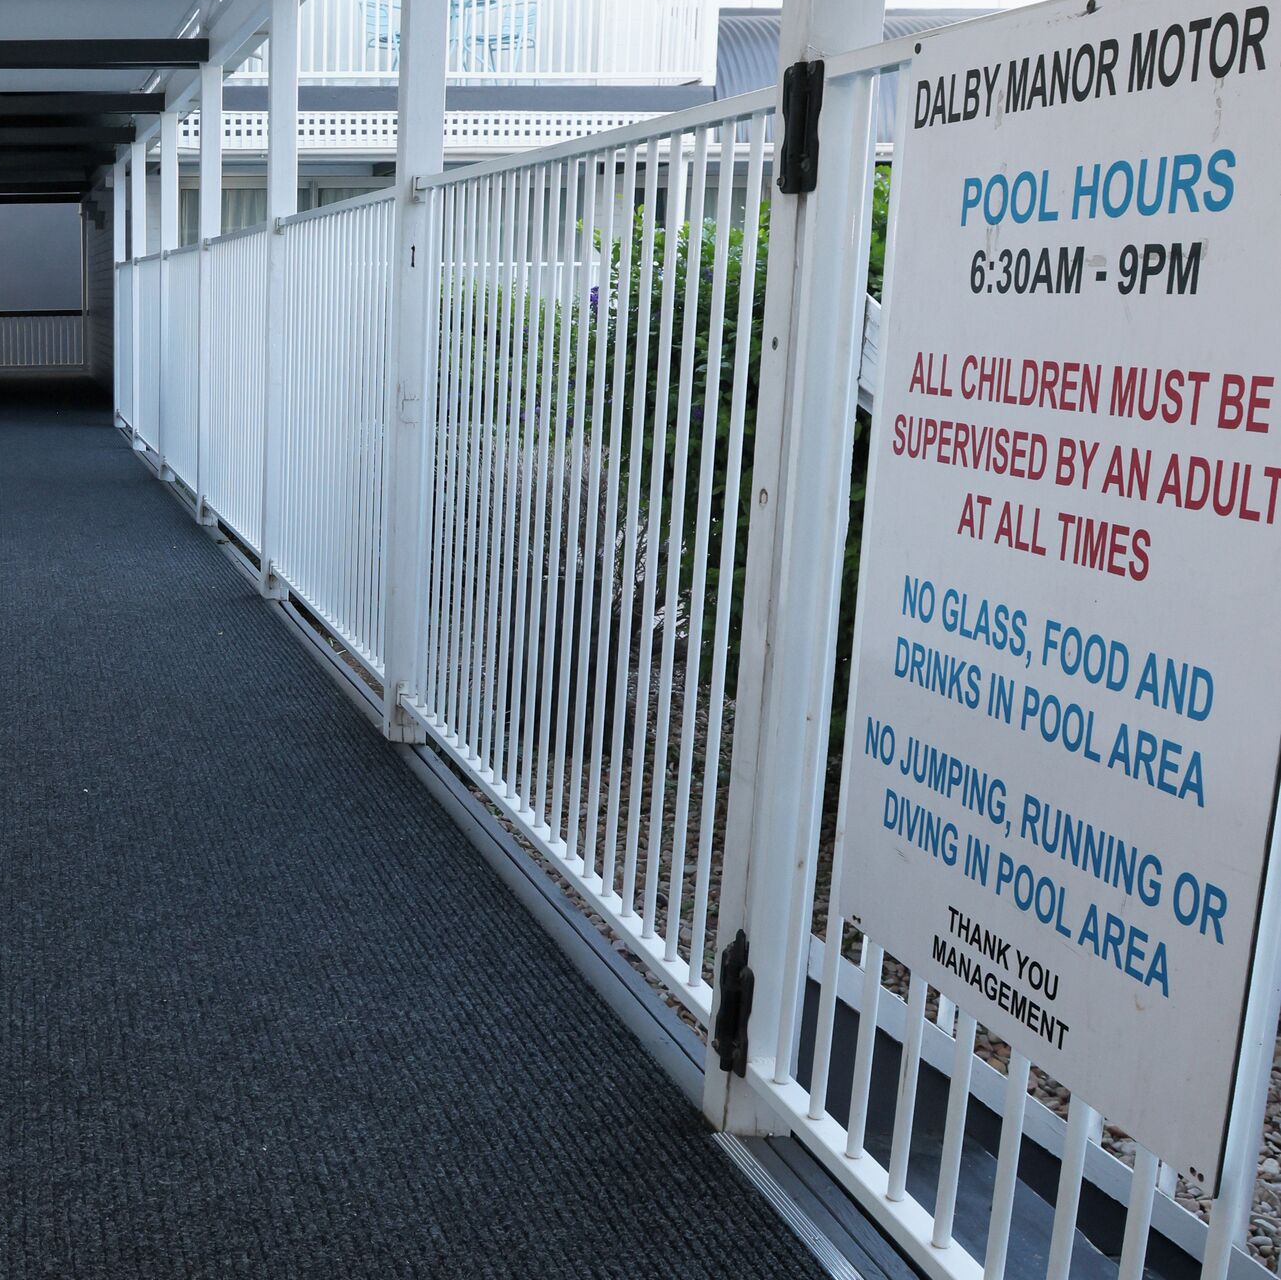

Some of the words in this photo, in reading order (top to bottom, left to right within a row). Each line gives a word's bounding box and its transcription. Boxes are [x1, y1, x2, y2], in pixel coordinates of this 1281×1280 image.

[914, 64, 1002, 130] DALBY
[1004, 39, 1120, 114] MANOR
[1128, 5, 1270, 93] MOTOR
[960, 170, 1059, 227] POOL
[1071, 149, 1237, 221] HOURS
[970, 246, 1085, 295] 6:30AM
[1095, 270, 1108, 282] -
[1117, 242, 1203, 296] 9PM
[908, 351, 953, 397] ALL
[960, 354, 1102, 414] CHILDREN
[1109, 365, 1211, 426] MUST
[1217, 373, 1275, 434] BE
[892, 413, 1048, 481] SUPERVISED
[1055, 437, 1101, 490] BY
[1101, 445, 1152, 502] AN
[1156, 453, 1281, 525] ADULT
[957, 492, 992, 541] AT
[993, 500, 1047, 557] ALL
[1057, 512, 1151, 582] TIMES
[902, 574, 936, 624] NO
[941, 588, 1032, 670] GLASS,
[1041, 619, 1131, 693] FOOD
[1134, 651, 1214, 722] AND
[894, 635, 982, 710] DRINKS
[987, 672, 1015, 725] IN
[1020, 685, 1102, 764] POOL
[1106, 722, 1206, 809] AREA
[864, 716, 896, 766] NO
[899, 735, 1012, 839] JUMPING,
[1020, 793, 1163, 908] RUNNING
[1172, 871, 1228, 946] OR
[883, 787, 959, 867] DIVING
[963, 833, 991, 888] IN
[995, 851, 1072, 939] POOL
[1076, 903, 1170, 999] AREA
[931, 933, 1070, 1051] MANAGEMENT
[947, 904, 1012, 972] THANK
[1015, 948, 1060, 1003] YOU
